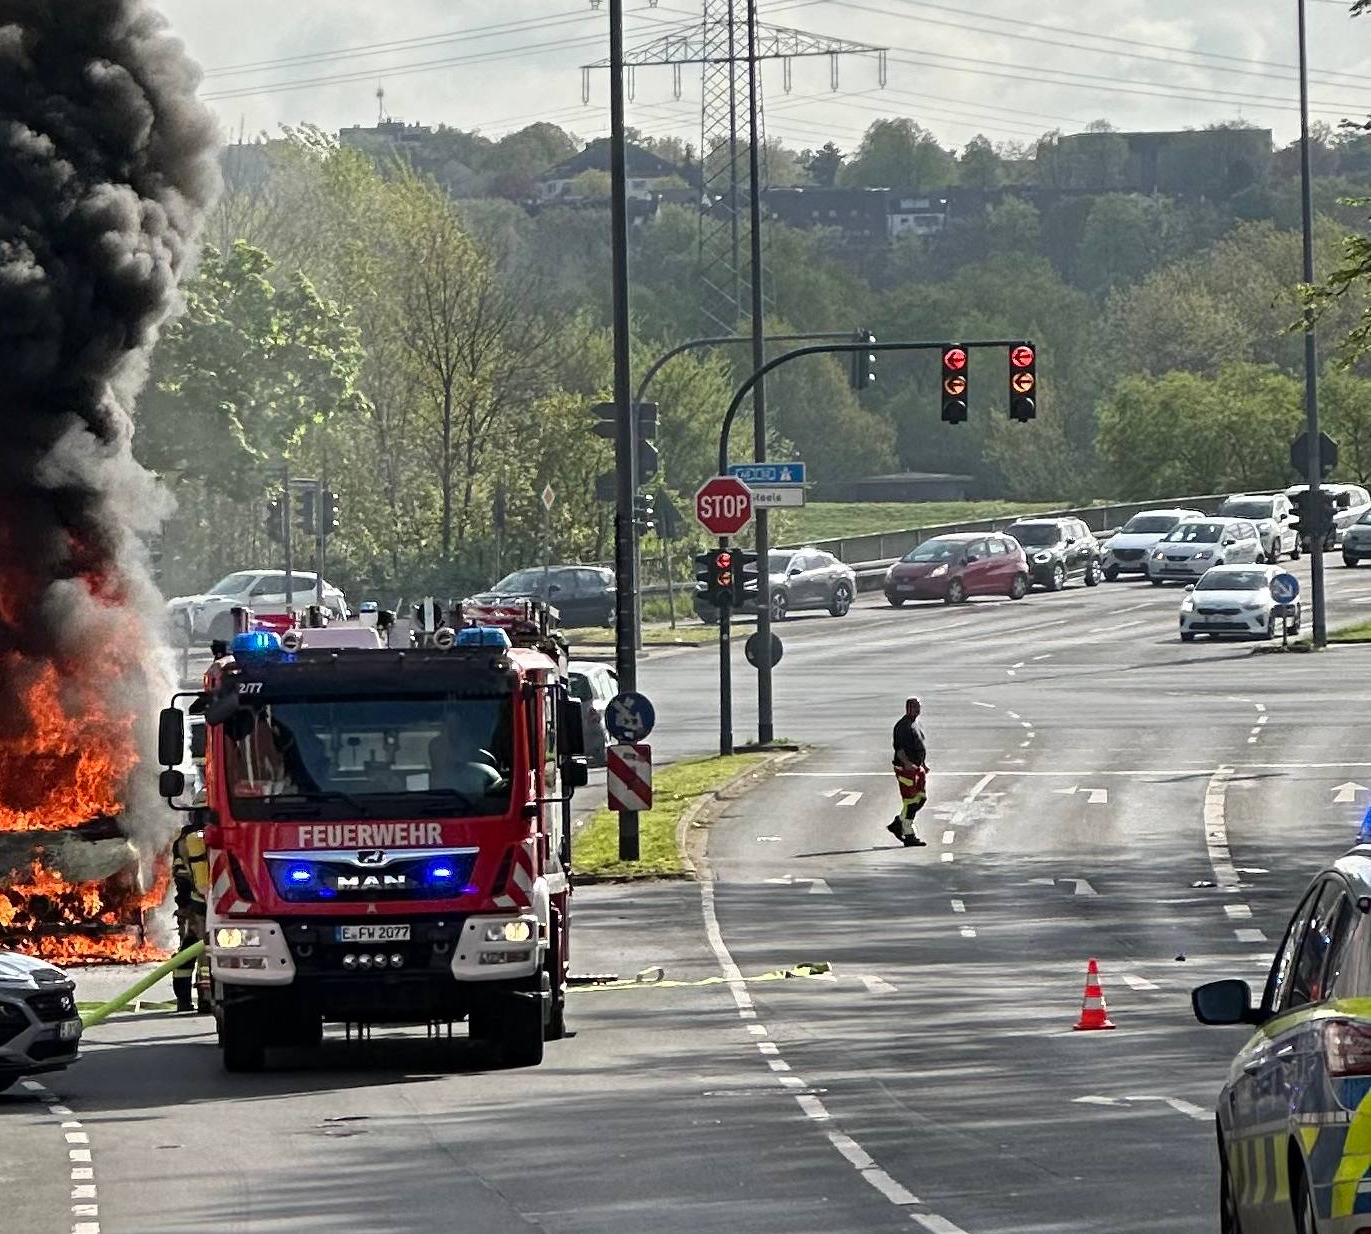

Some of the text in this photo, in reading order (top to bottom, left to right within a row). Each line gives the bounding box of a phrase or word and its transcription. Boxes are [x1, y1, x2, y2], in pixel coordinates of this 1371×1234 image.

[700, 495, 748, 519] STOP
[238, 682, 263, 694] 2/77
[298, 823, 444, 849] FEUERWEHR
[337, 875, 406, 890] MAN
[342, 926, 409, 940] E FW 2077
